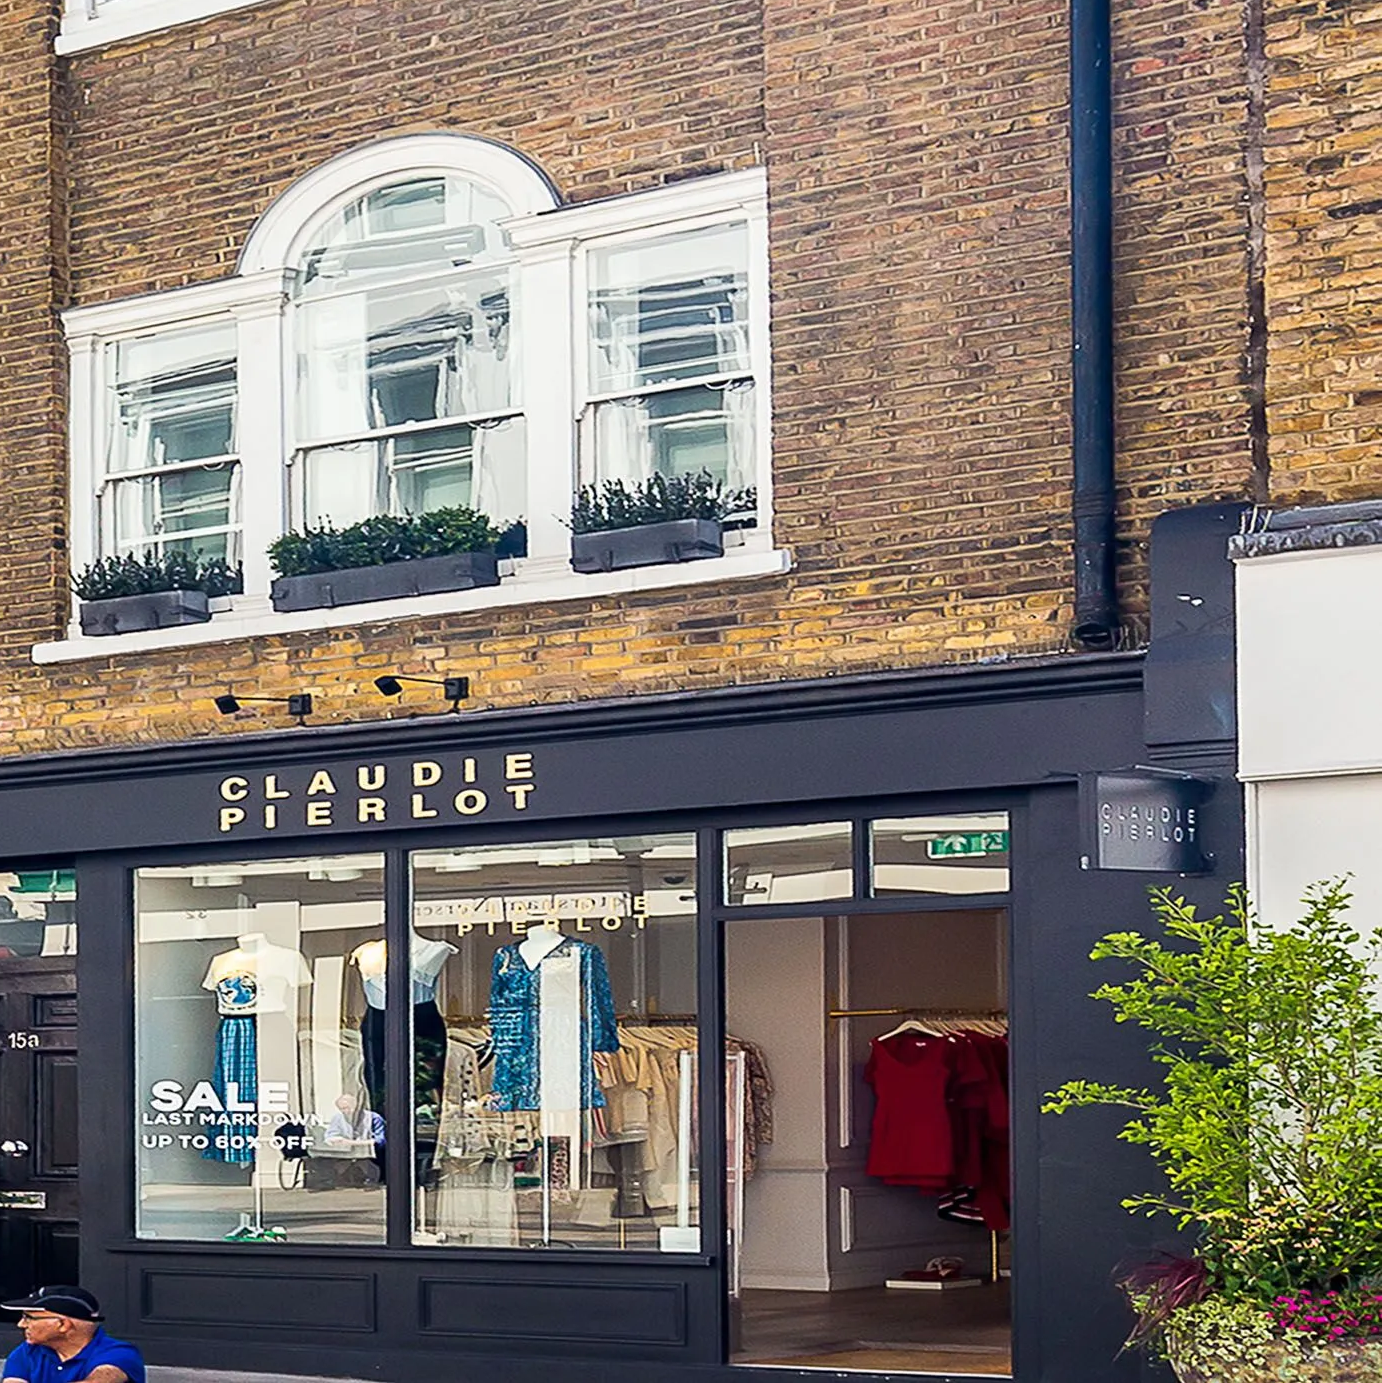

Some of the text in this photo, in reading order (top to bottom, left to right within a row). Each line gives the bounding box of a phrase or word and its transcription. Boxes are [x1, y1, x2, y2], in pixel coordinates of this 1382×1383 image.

[219, 753, 533, 802] CLAUDIE
[219, 784, 535, 832] PIERLOT
[1101, 803, 1195, 824] CLAUDIE
[1102, 822, 1195, 842] PIERLOT
[457, 914, 650, 937] PIERLOT
[7, 1032, 39, 1049] 15a
[150, 1080, 289, 1112] SALE
[142, 1112, 324, 1126] LAST MARKDOWN
[142, 1135, 315, 1150] UP TO 60% OFF
